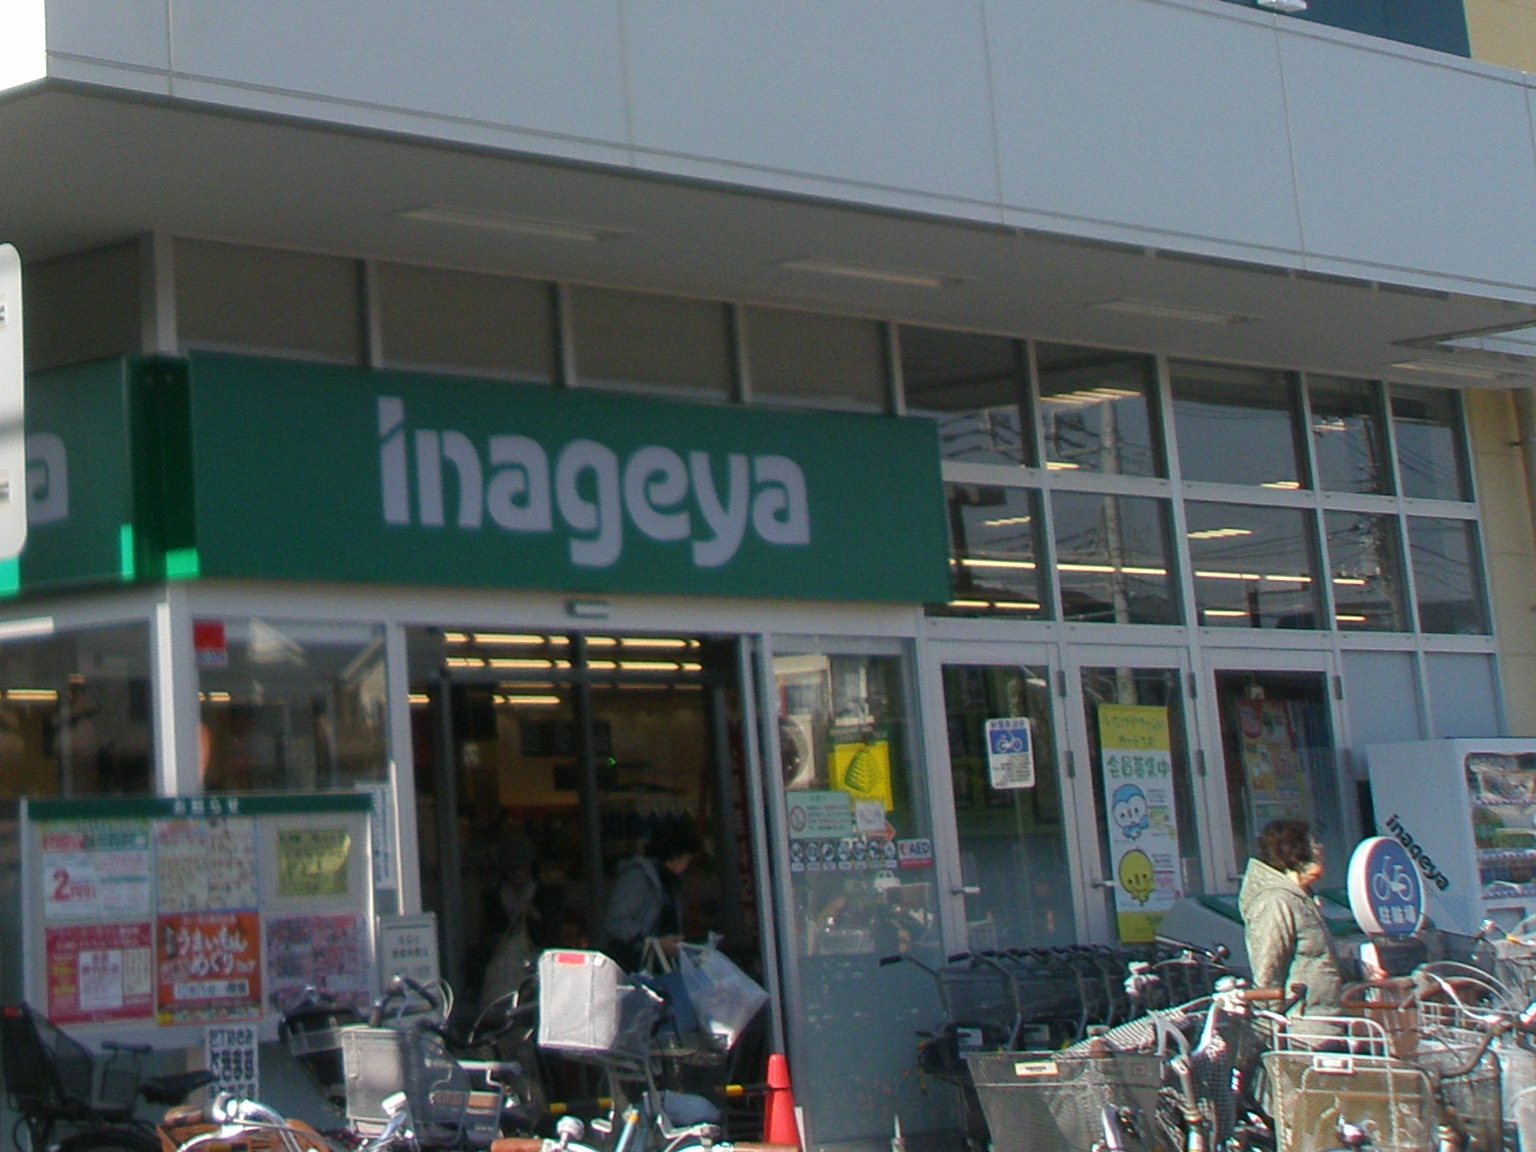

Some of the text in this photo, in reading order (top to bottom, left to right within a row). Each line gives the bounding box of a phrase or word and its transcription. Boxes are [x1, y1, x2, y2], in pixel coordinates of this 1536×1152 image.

[377, 395, 811, 568] inageya
[1107, 755, 1170, 780] 会員募集中
[1385, 814, 1450, 891] inageya
